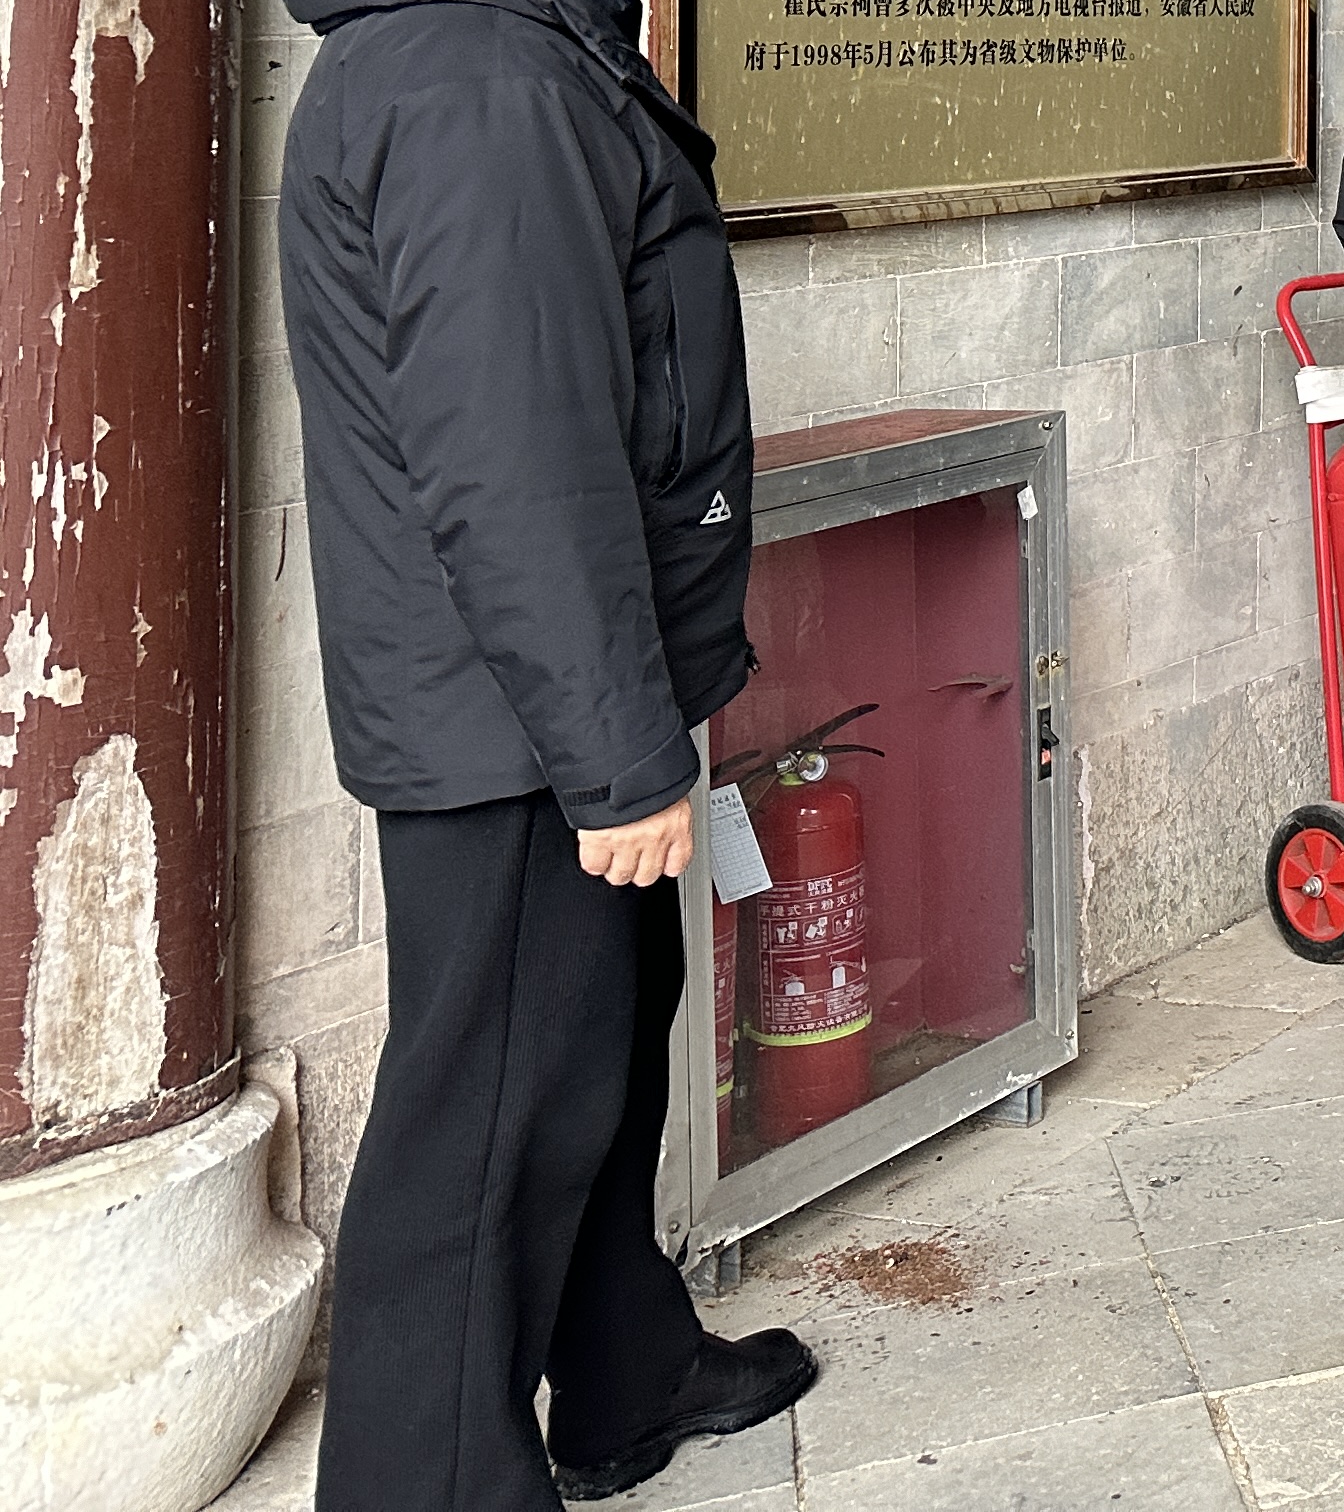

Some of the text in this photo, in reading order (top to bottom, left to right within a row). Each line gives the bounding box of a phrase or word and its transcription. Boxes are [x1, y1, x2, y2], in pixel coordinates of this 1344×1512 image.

[743, 37, 1135, 70] 府于1998年5月公布其为省级文物保护单位。
